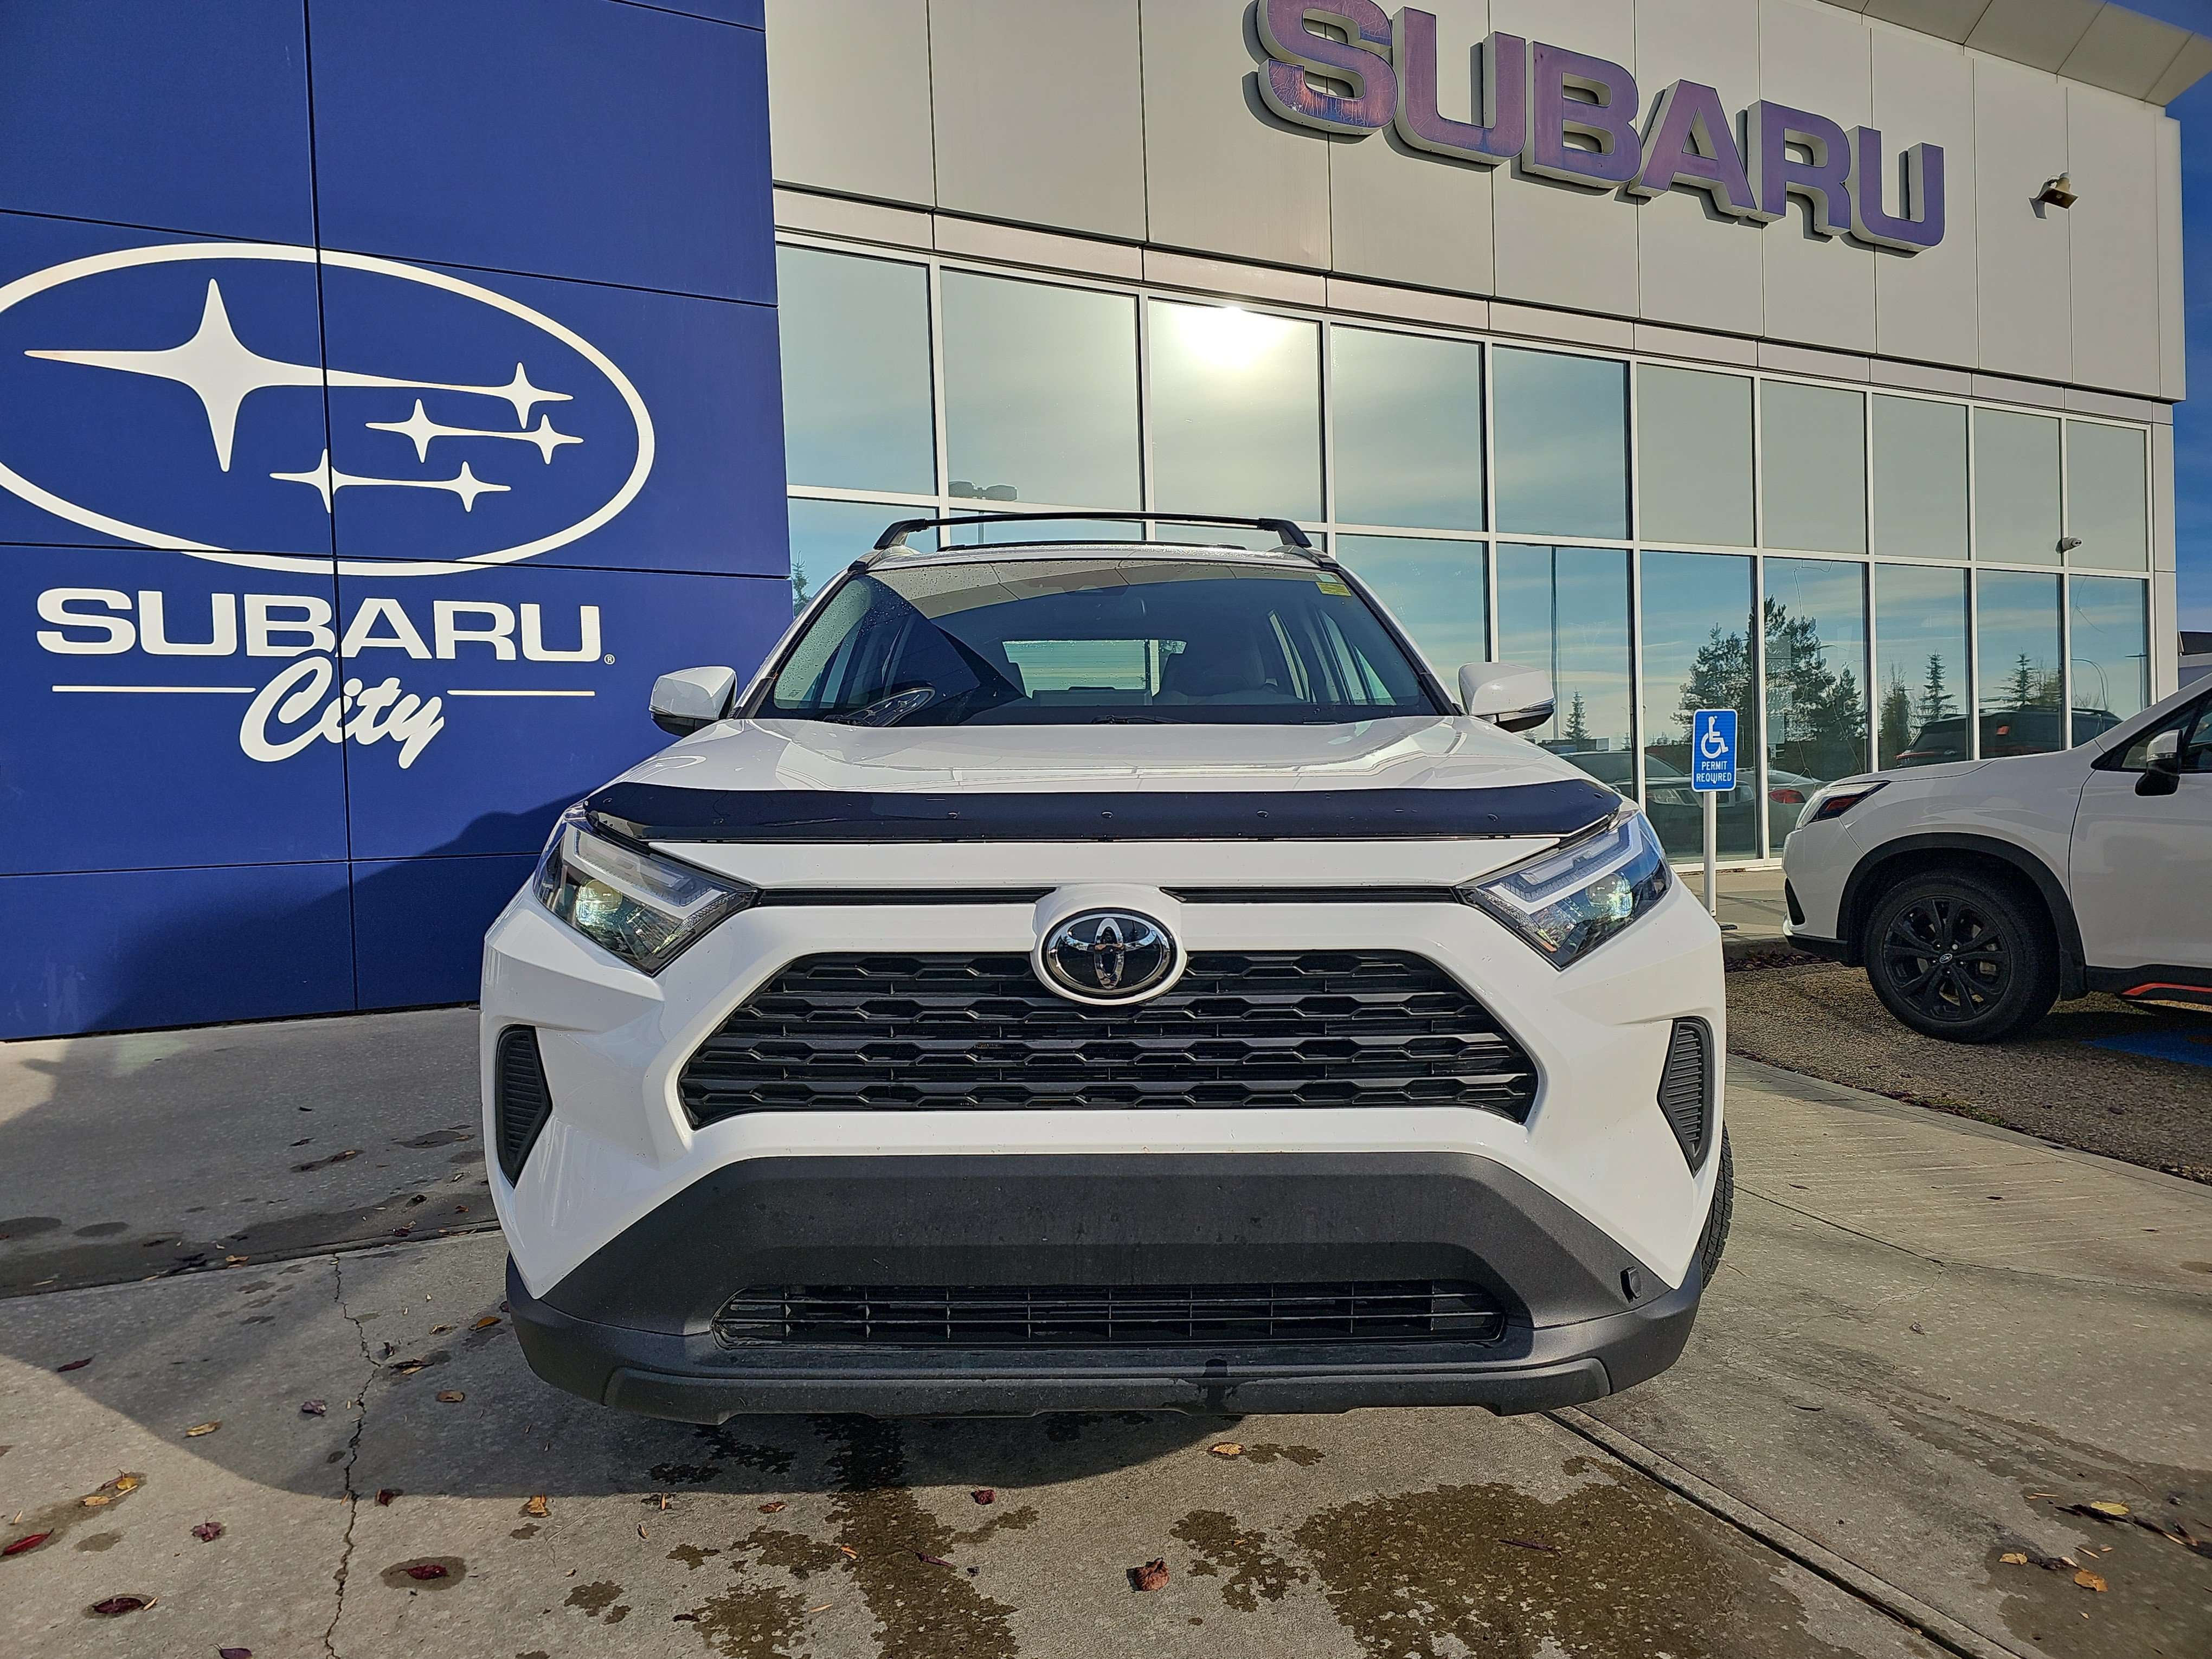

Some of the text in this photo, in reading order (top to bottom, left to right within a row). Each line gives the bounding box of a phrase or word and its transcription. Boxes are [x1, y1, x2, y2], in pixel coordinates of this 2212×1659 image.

[1258, 0, 1945, 253] SUBARU
[240, 656, 445, 769] City
[1696, 772, 1732, 782] REQUIRED
[1701, 761, 1728, 770] PERMIT
